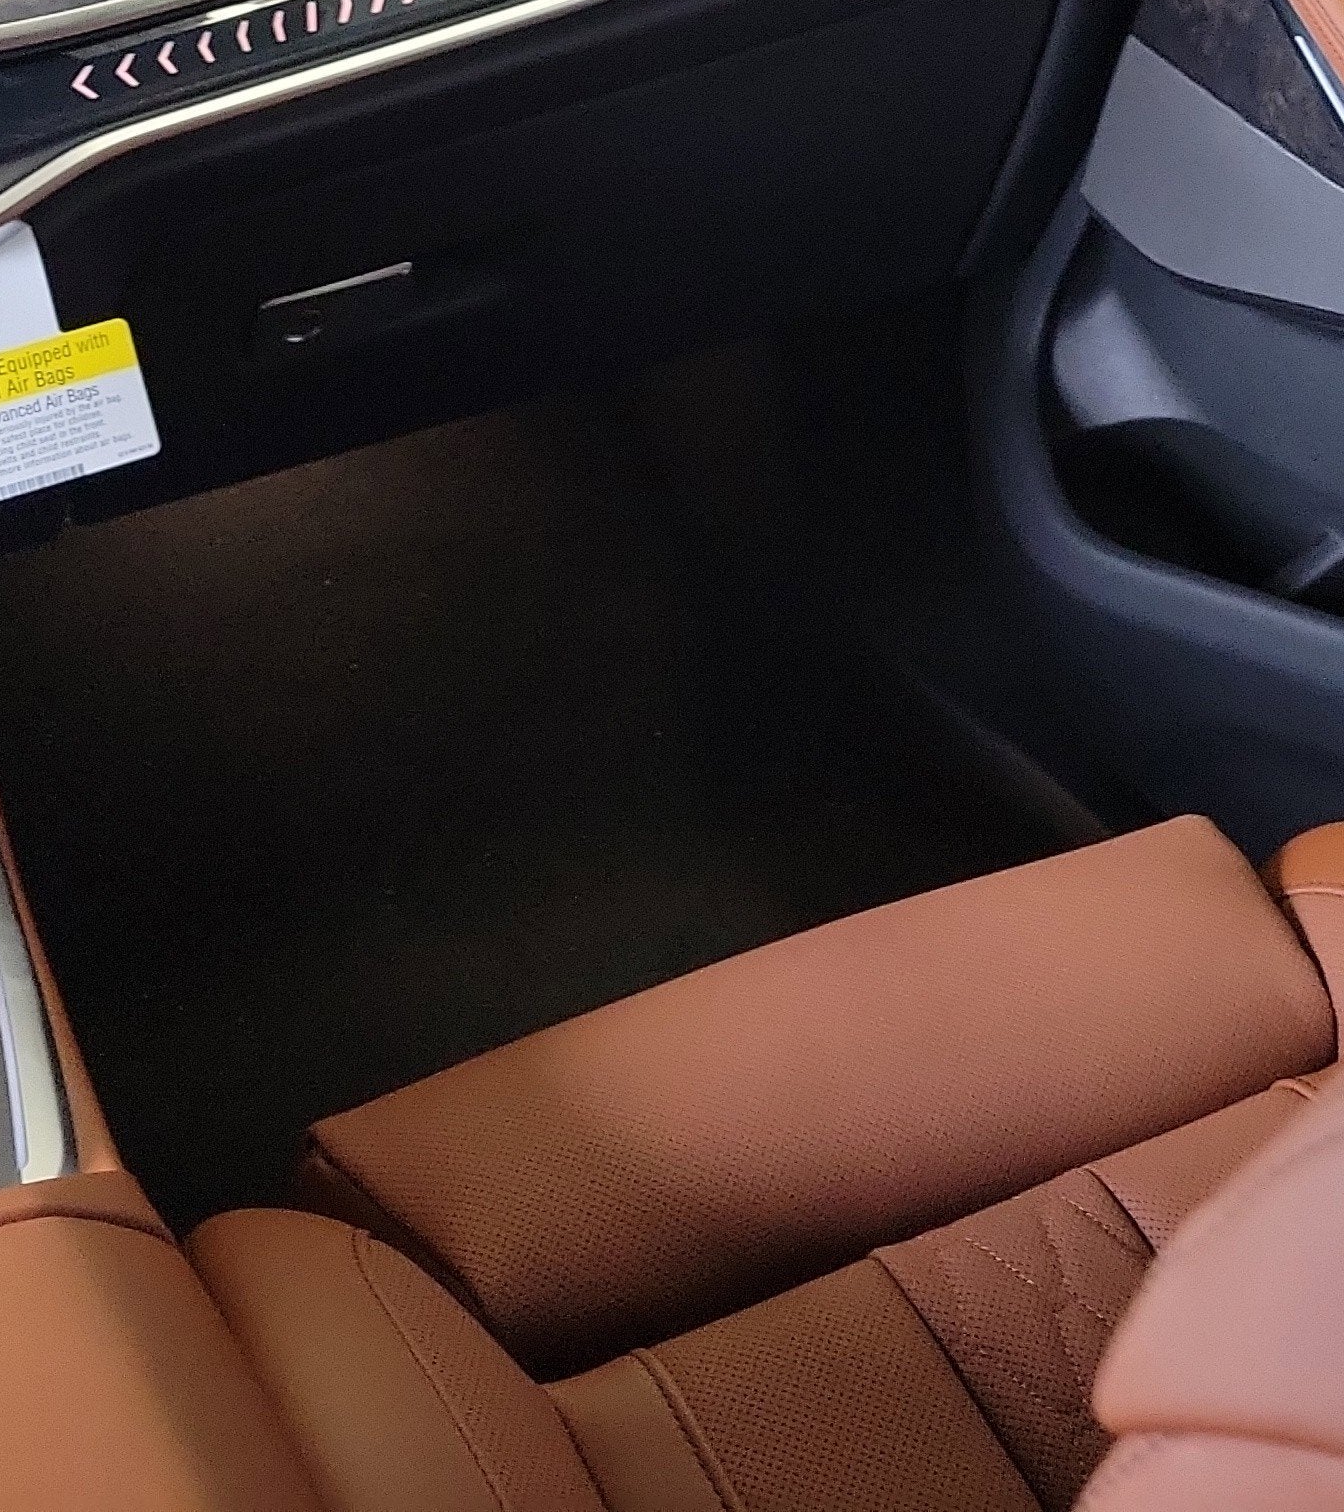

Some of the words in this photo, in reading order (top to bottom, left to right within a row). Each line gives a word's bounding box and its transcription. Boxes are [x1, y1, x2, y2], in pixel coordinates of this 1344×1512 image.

[75, 331, 110, 354] with
[7, 376, 30, 397] Air
[34, 366, 75, 388] Bags
[45, 393, 64, 410] Air
[66, 385, 100, 404] Bags
